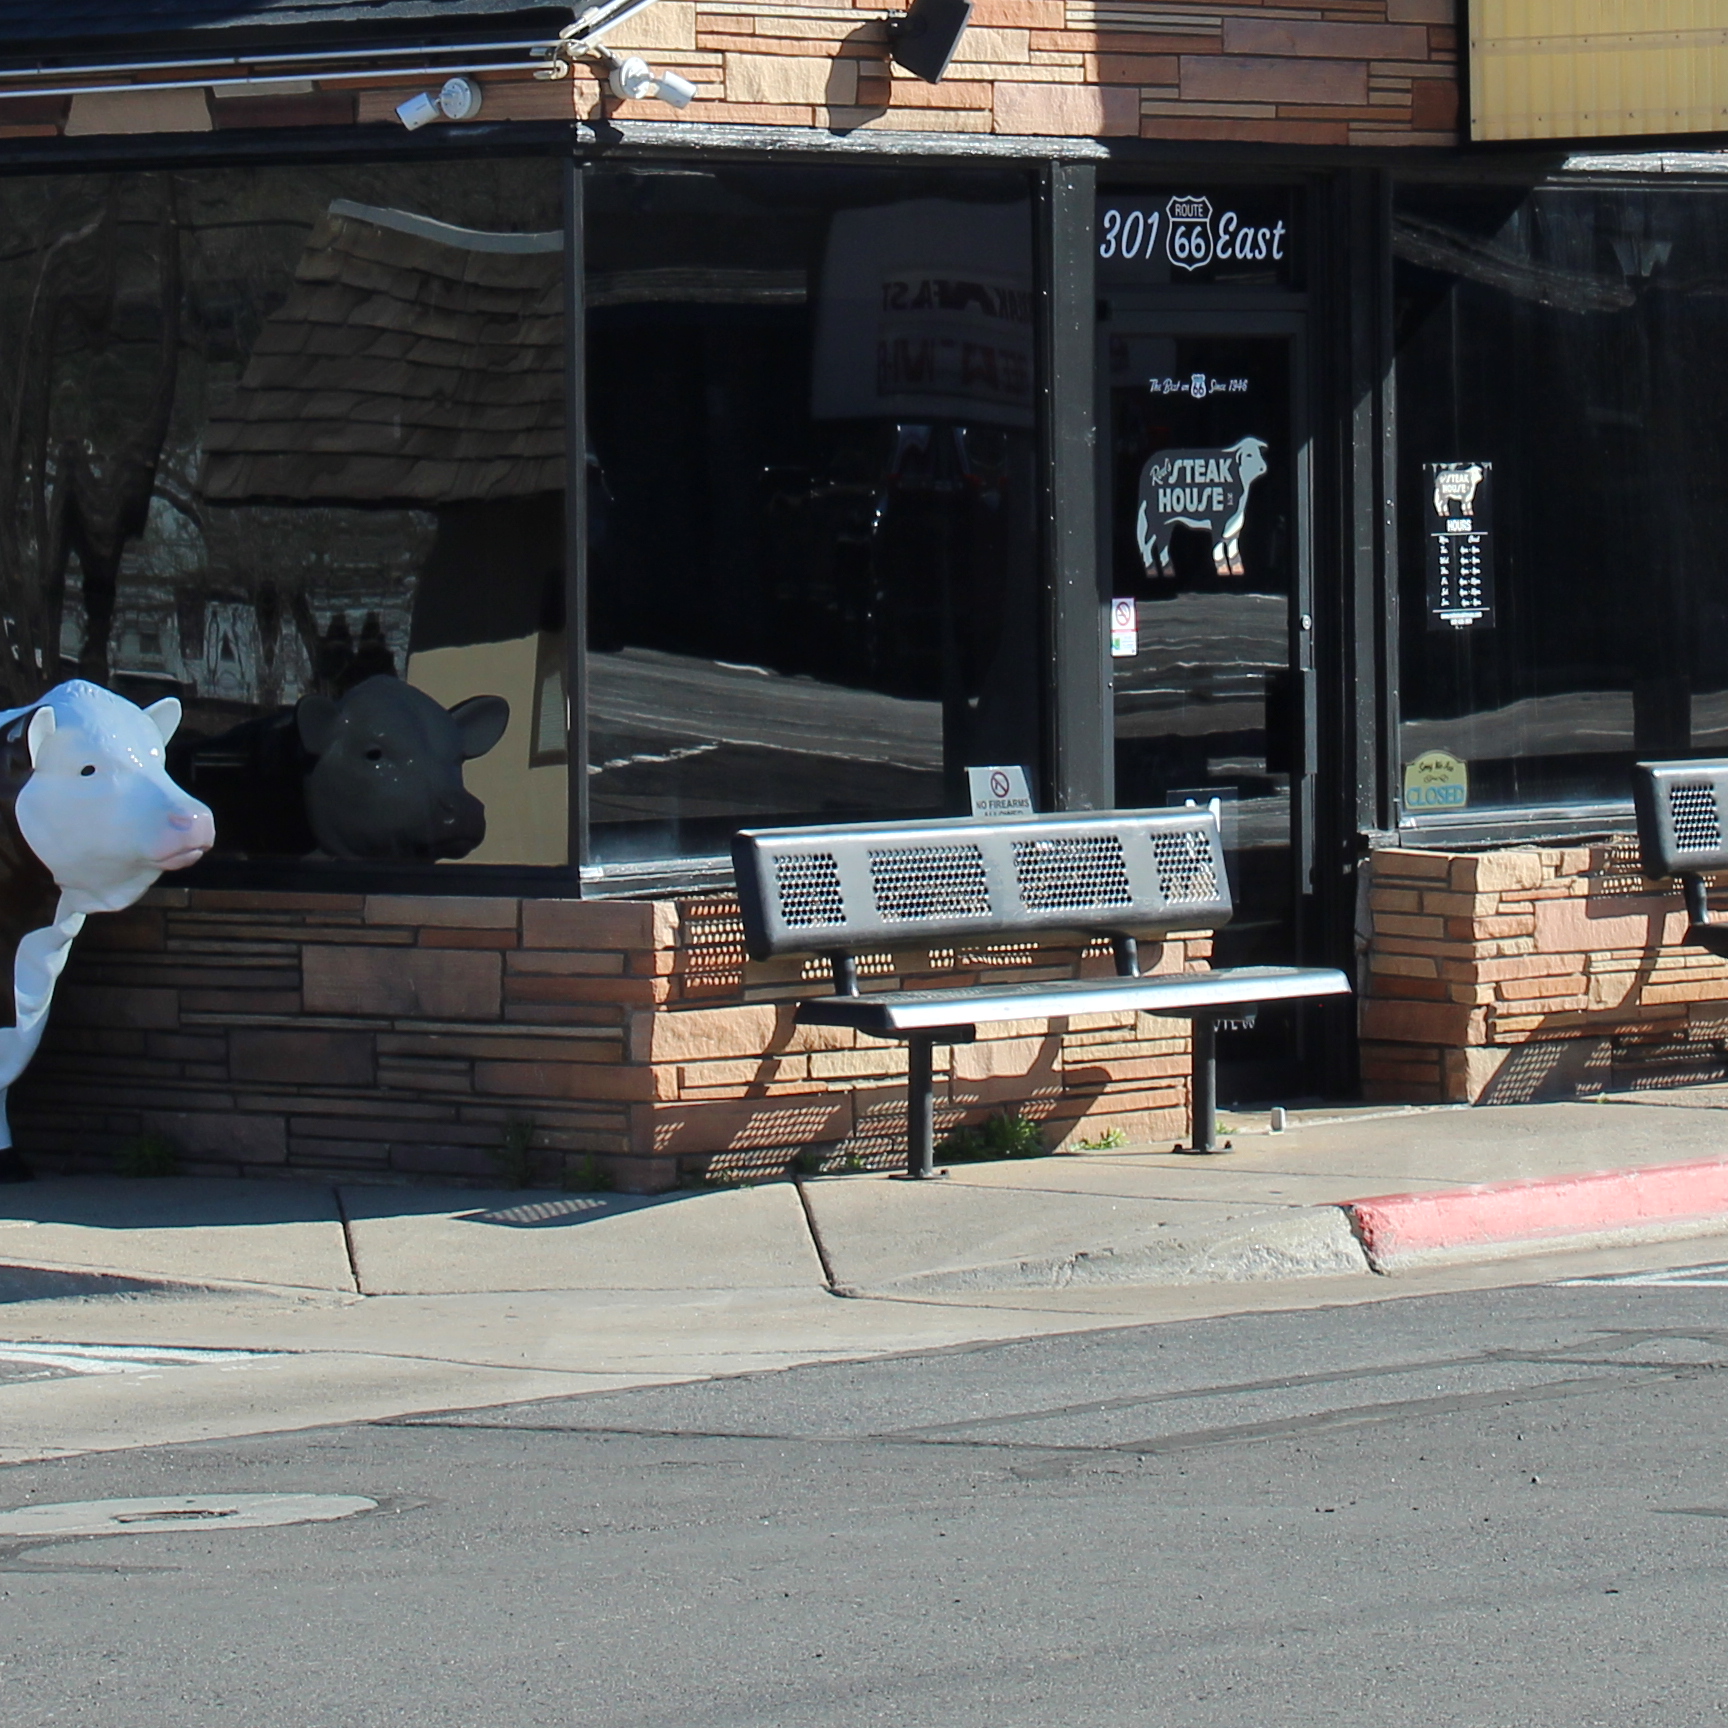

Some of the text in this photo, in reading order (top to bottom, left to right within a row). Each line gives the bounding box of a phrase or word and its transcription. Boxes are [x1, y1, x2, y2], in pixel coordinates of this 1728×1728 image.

[1174, 203, 1203, 217] ROUTE
[1099, 209, 1160, 260] 301
[1173, 226, 1206, 260] 66
[1216, 211, 1286, 261] East
[1168, 457, 1234, 484] STEAK
[1158, 486, 1224, 513] HOUSE
[976, 798, 1029, 809] NO FIREARMS
[1406, 783, 1465, 806] CLOSED
